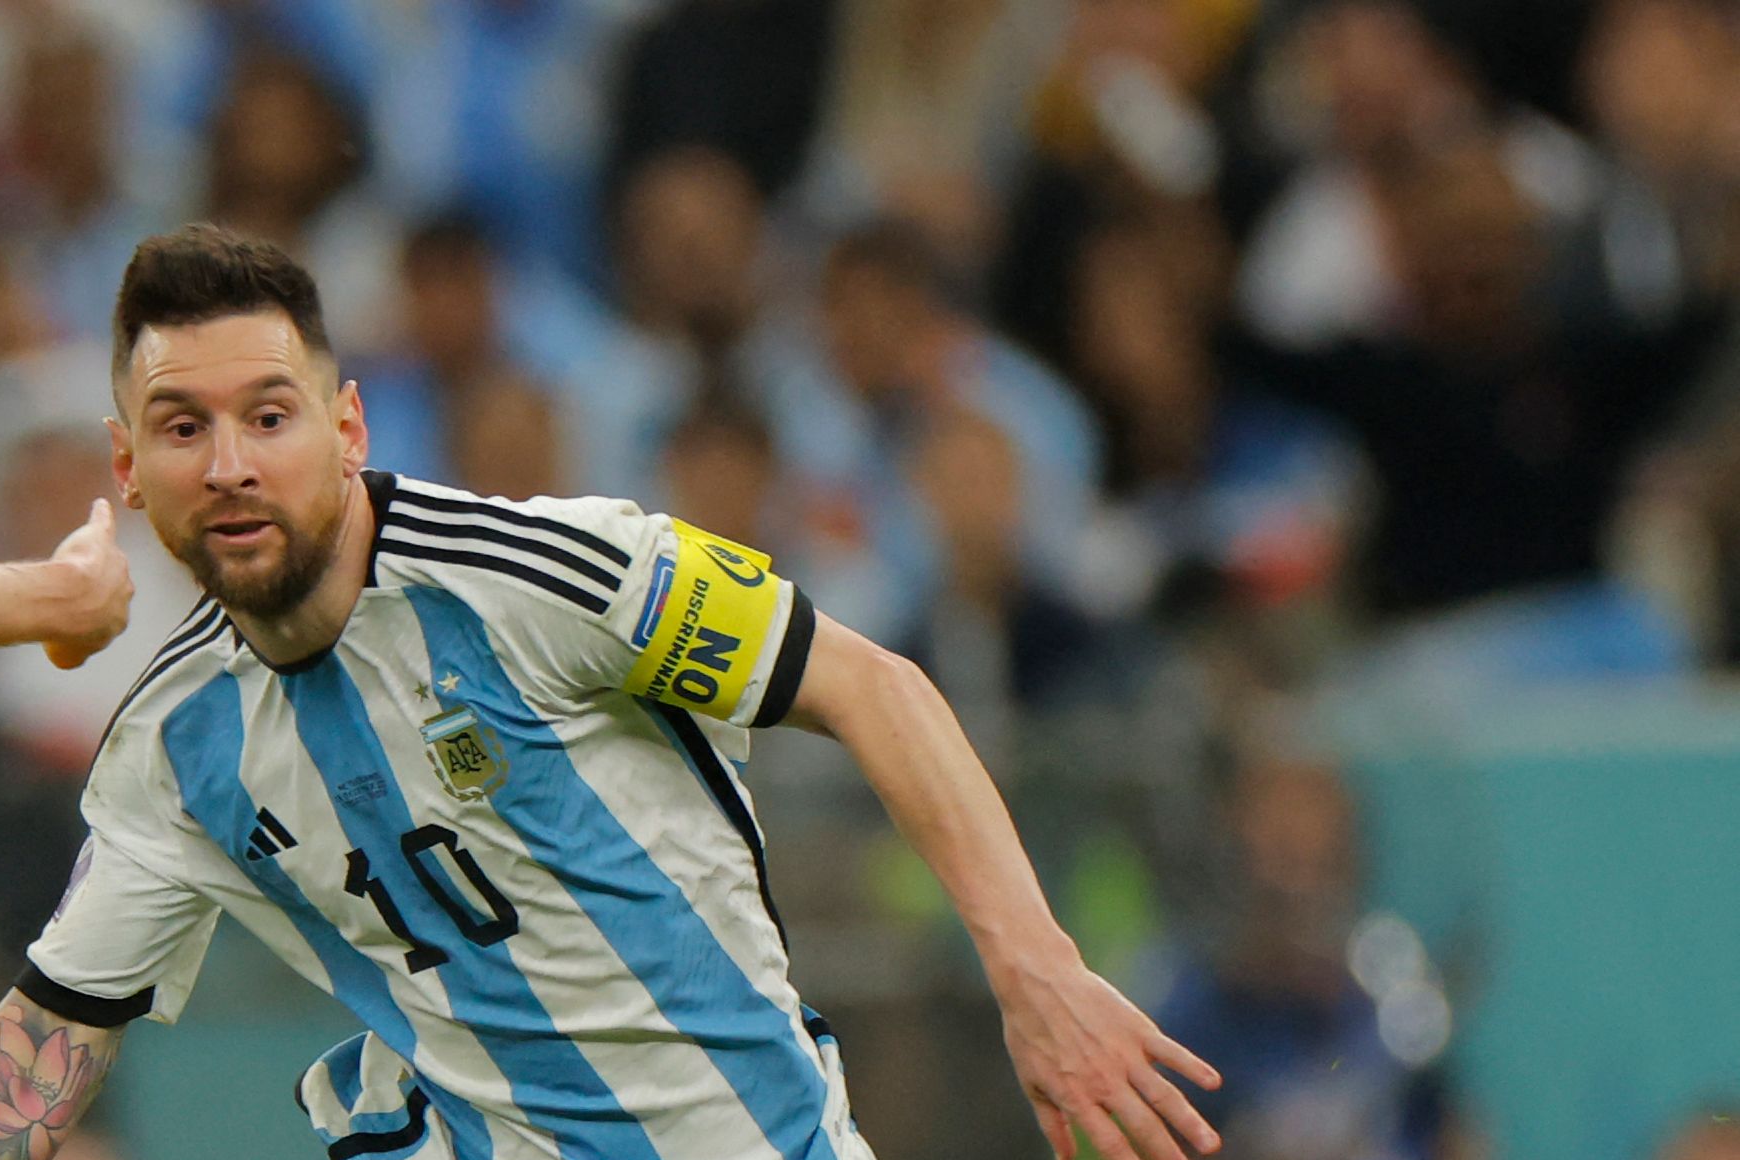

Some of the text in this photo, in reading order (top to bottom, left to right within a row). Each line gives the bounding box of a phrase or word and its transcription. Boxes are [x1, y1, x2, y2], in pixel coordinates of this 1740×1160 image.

[672, 626, 742, 704] NO
[443, 732, 488, 774] AFA
[344, 823, 520, 976] 10
